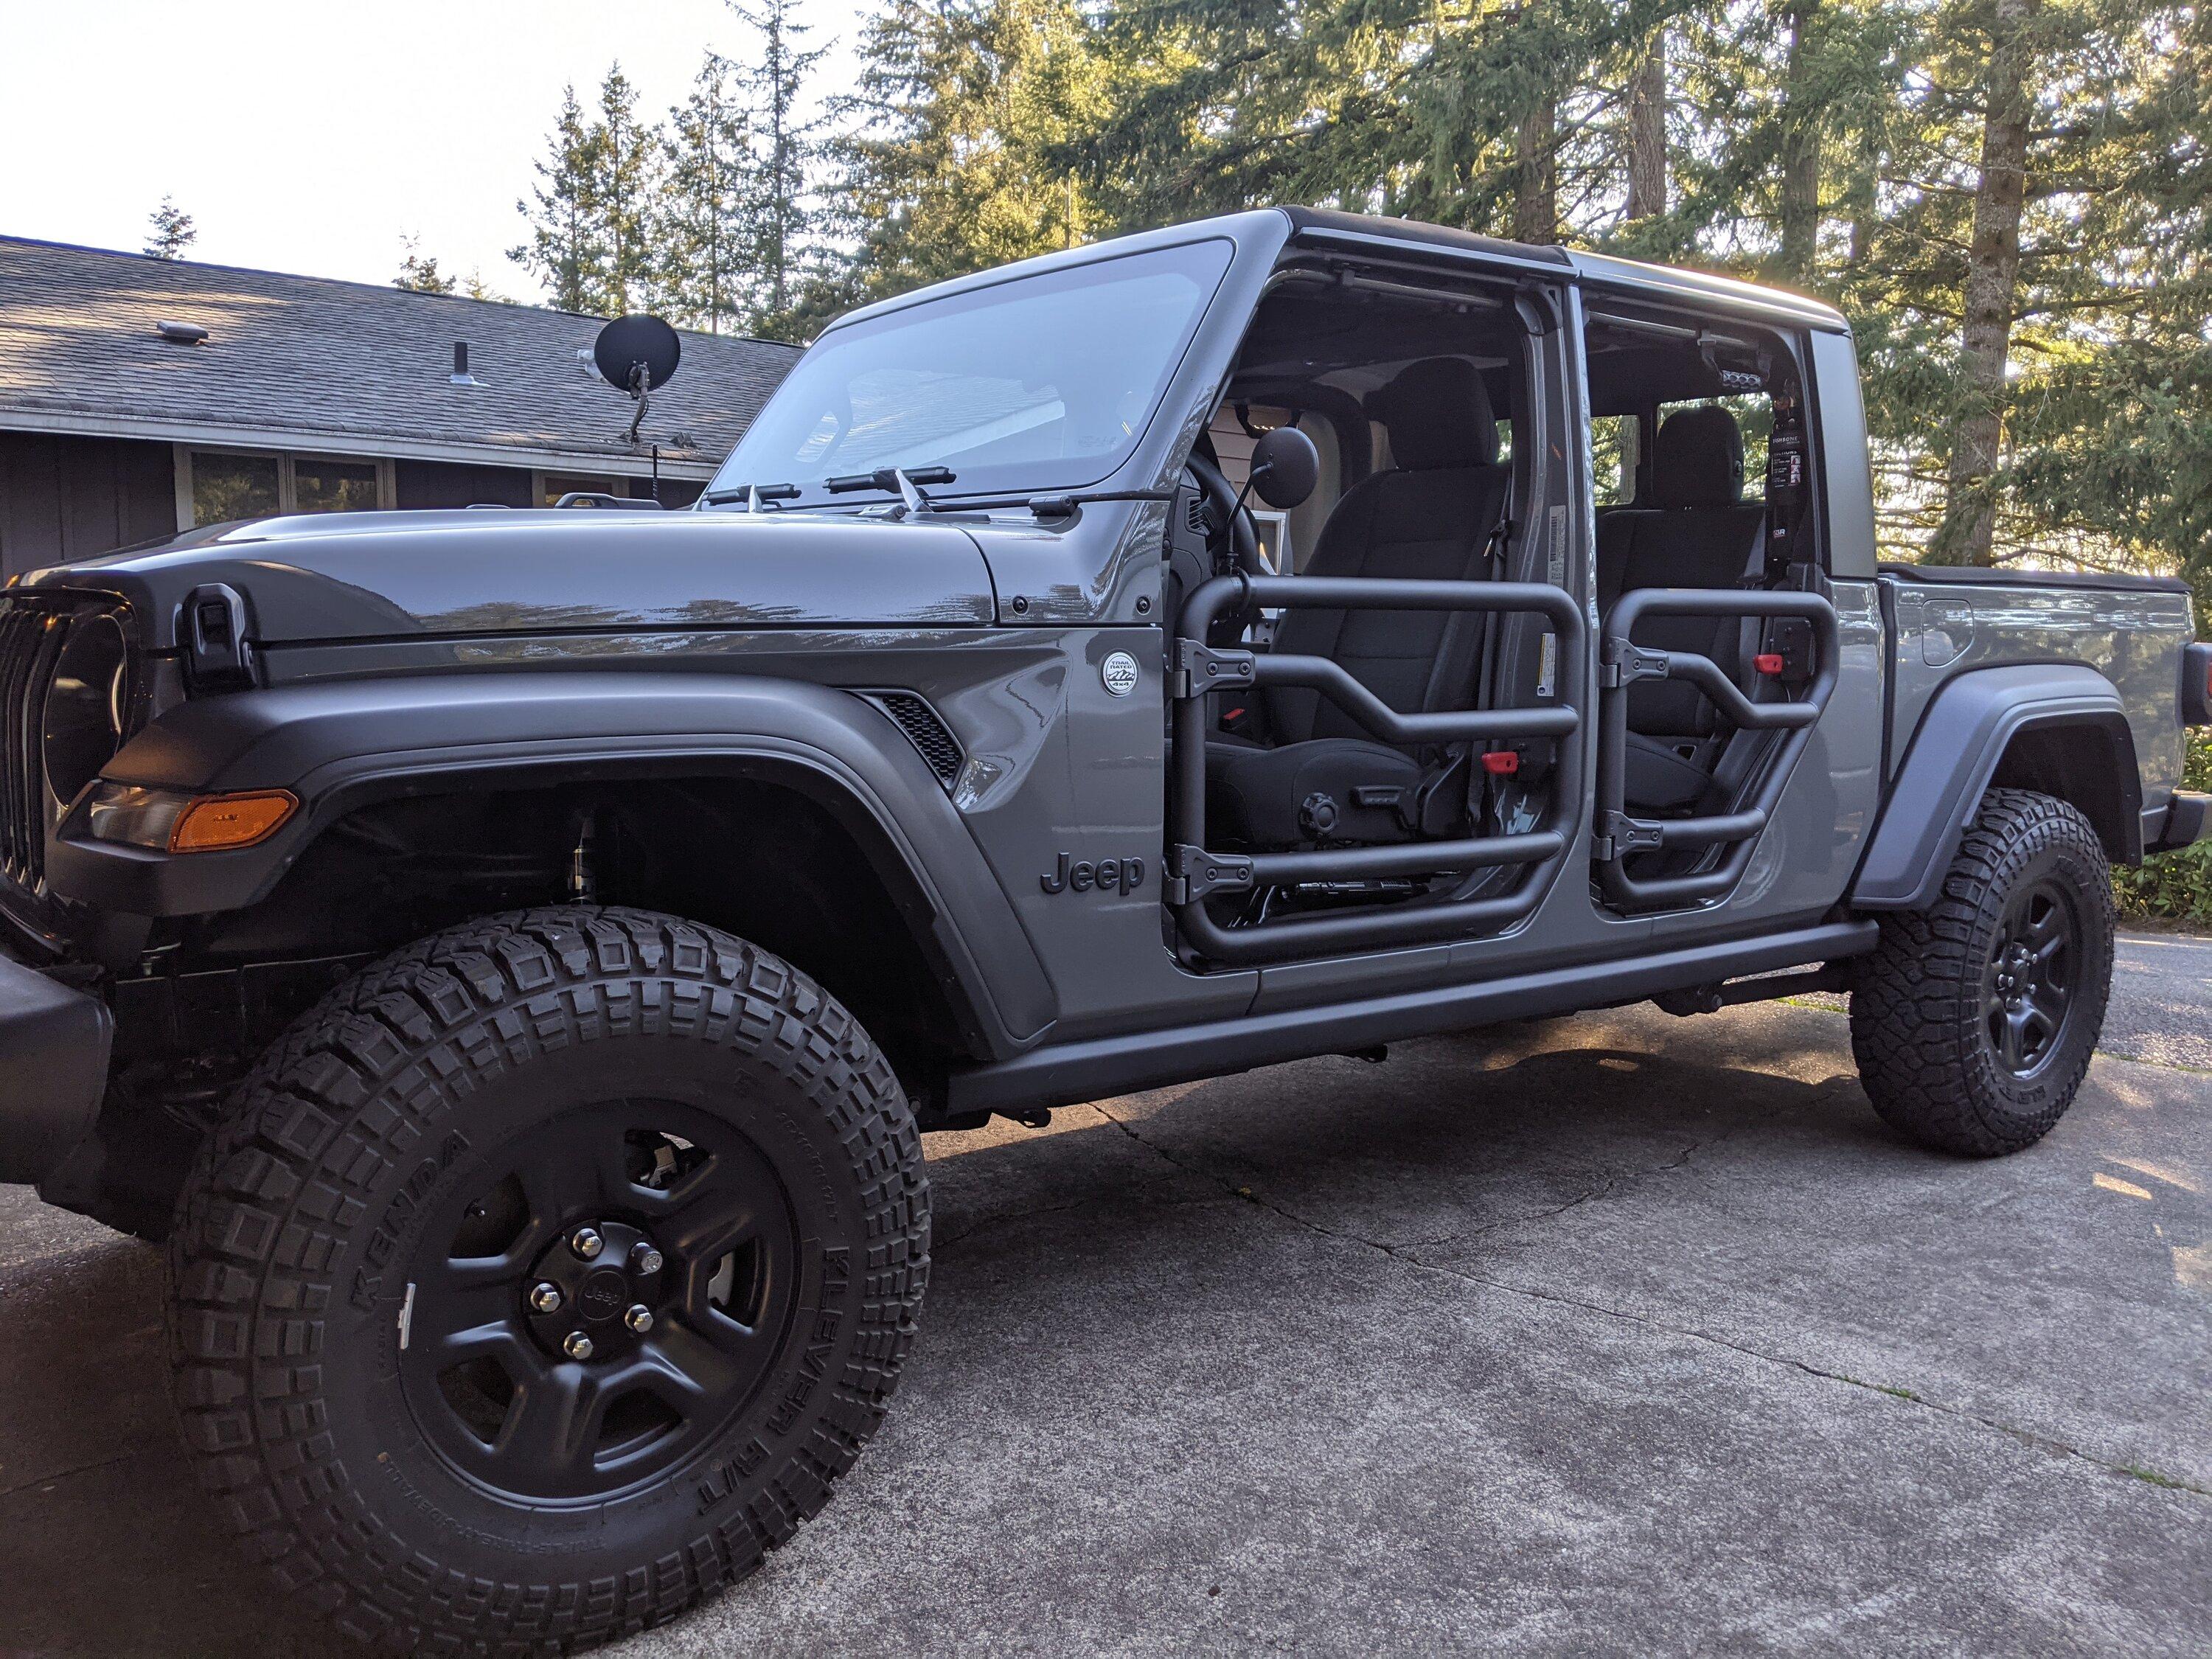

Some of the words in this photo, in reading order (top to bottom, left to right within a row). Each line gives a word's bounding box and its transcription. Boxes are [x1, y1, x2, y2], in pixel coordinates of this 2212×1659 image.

[1040, 852, 1146, 896] Jeep
[350, 1128, 470, 1312] KENDA
[759, 1246, 852, 1436] KLEVER
[698, 1438, 773, 1516] R/T
